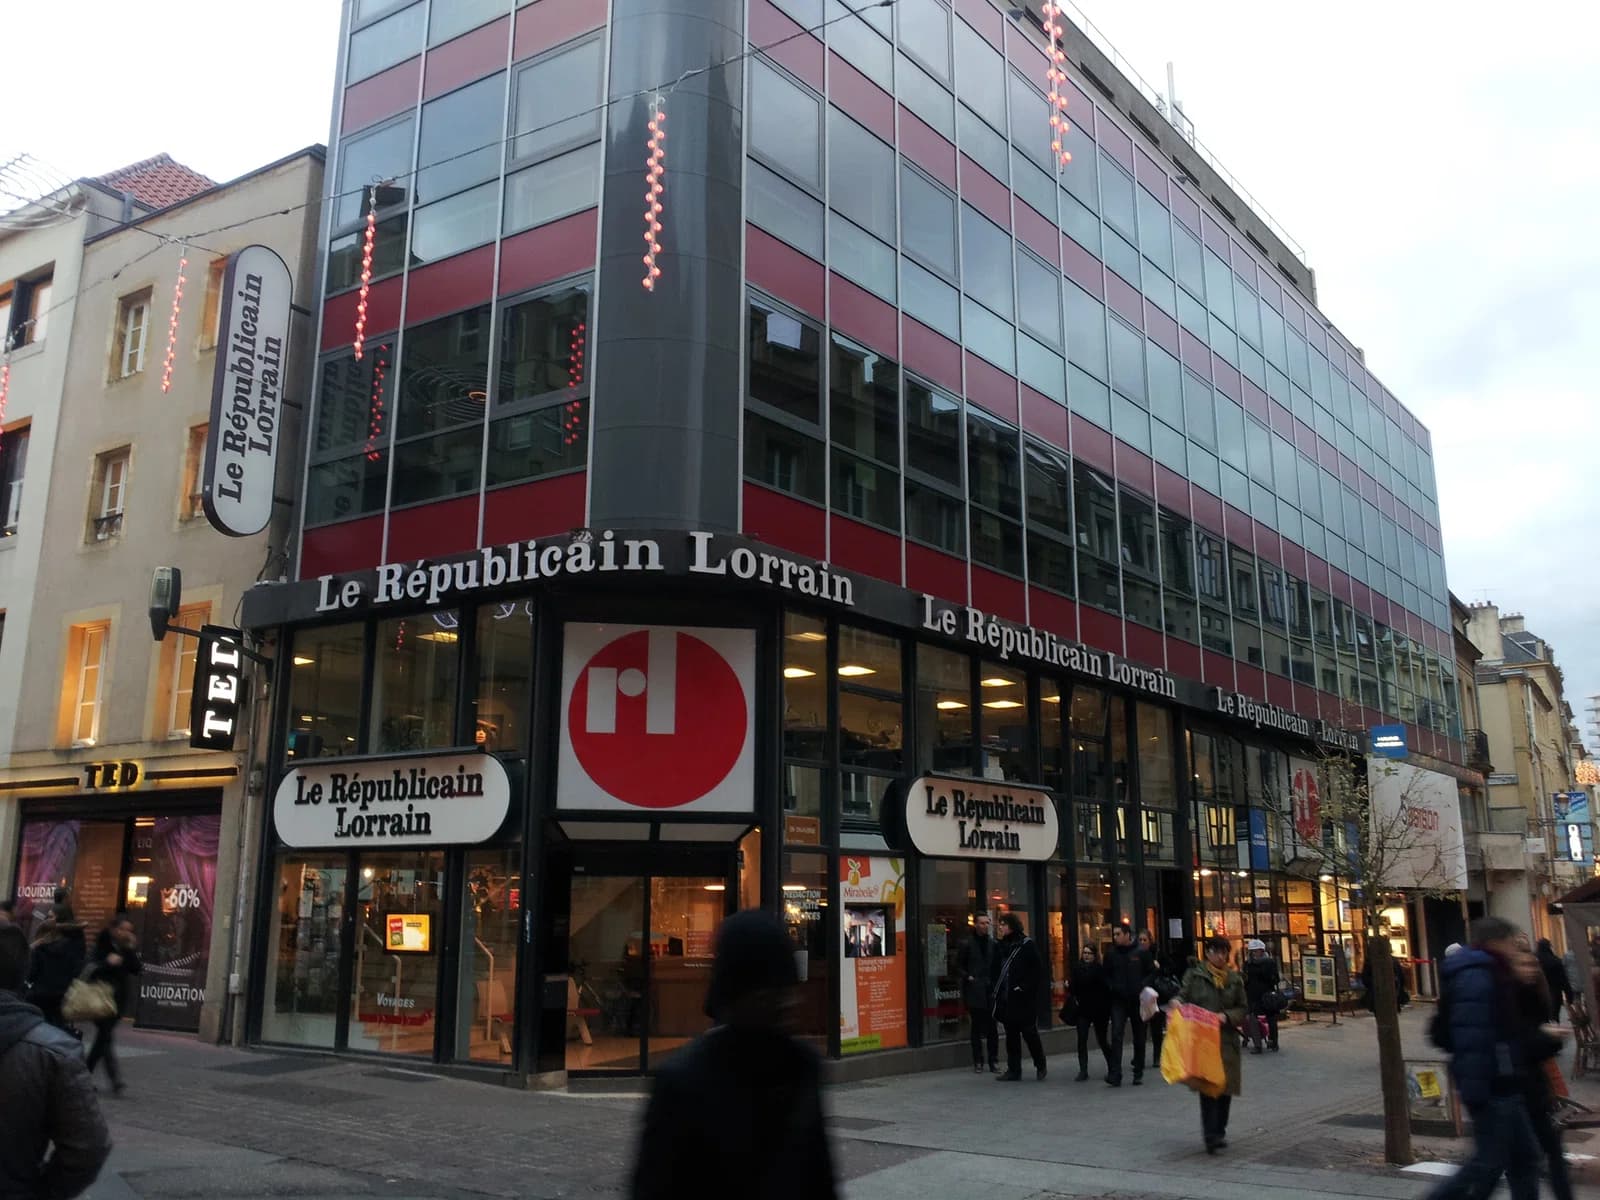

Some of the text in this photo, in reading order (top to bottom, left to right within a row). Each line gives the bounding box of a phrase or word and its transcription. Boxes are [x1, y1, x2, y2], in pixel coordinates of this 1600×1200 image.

[218, 273, 263, 504] Le Républicain
[248, 337, 283, 457] Lorrain
[315, 530, 855, 612] Le Républicain Lorrain
[922, 593, 1177, 698] Le Républicain Lorrain
[1216, 686, 1234, 714] Le
[1236, 693, 1310, 736] Républicain
[84, 762, 139, 788] TED
[294, 765, 484, 811] Le Républicain
[335, 804, 432, 838] Lorrain
[926, 786, 1046, 827] Le Républicain
[959, 820, 1021, 851] Lorrain
[141, 984, 206, 1001] LIQUIDATION
